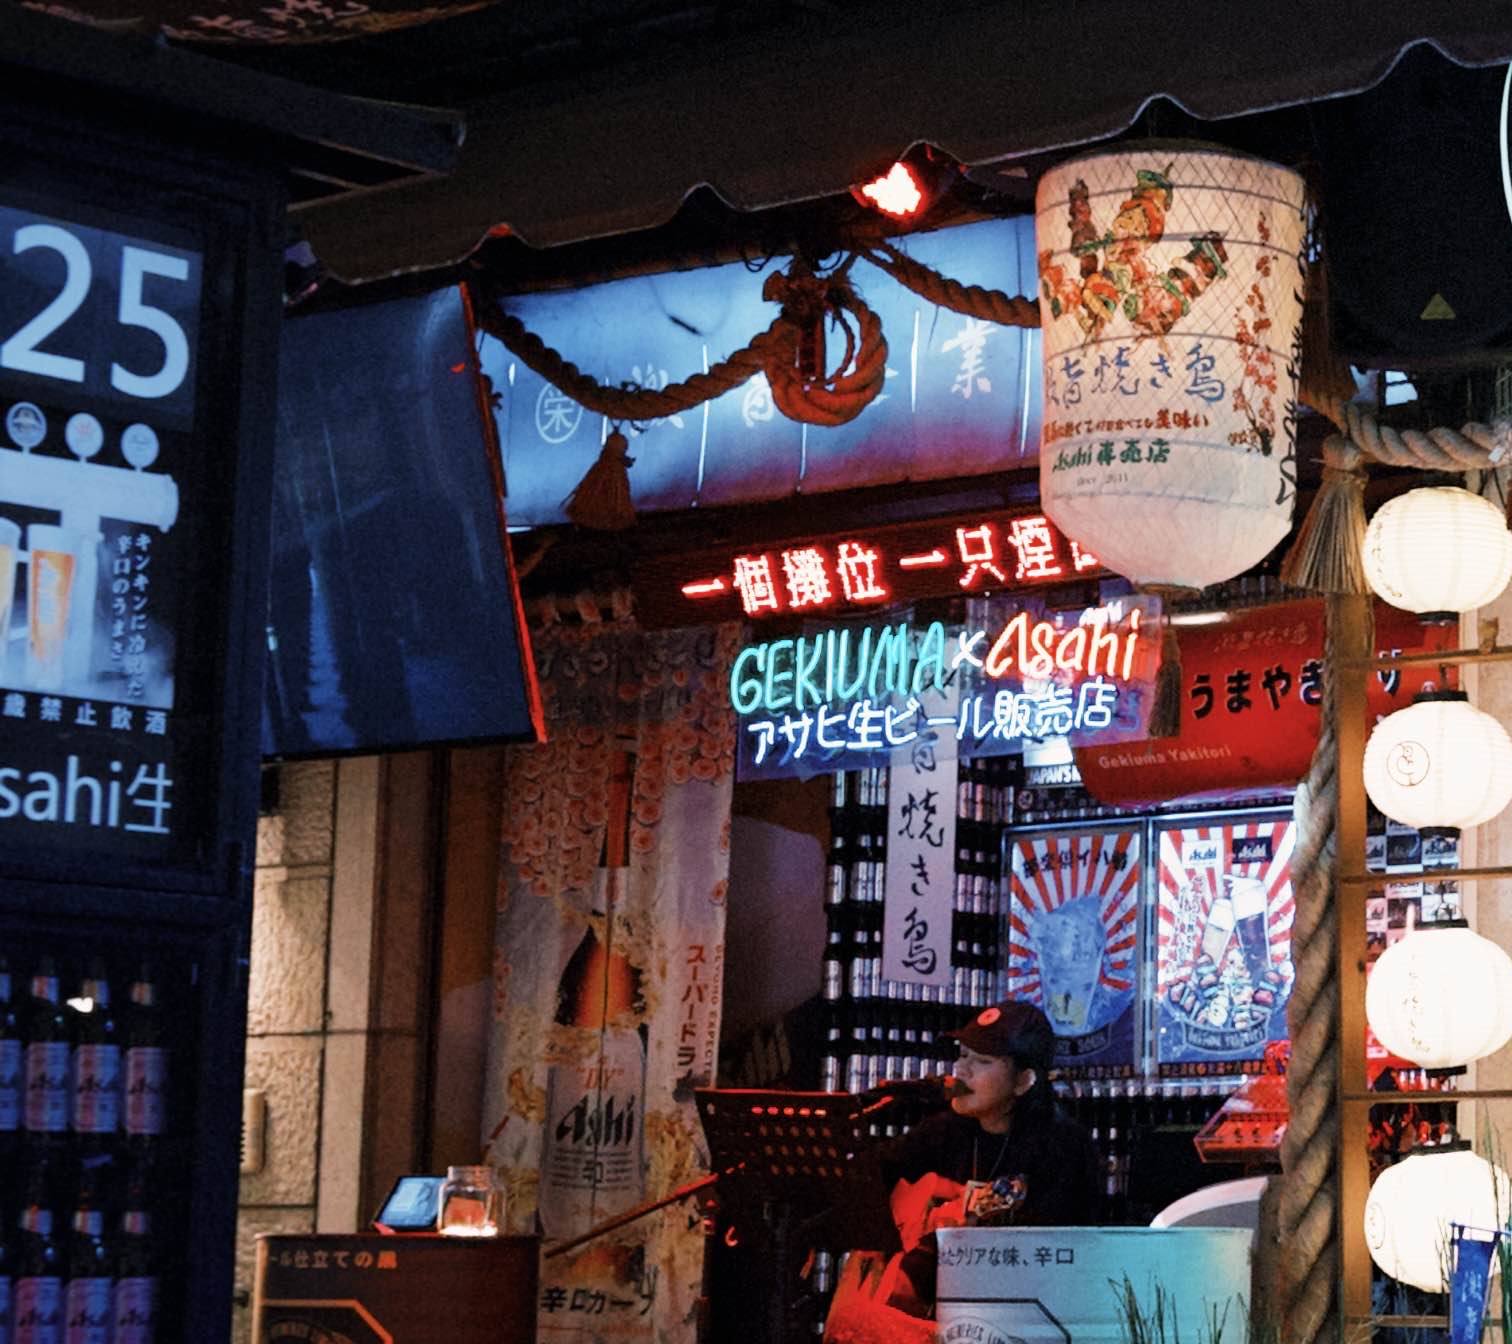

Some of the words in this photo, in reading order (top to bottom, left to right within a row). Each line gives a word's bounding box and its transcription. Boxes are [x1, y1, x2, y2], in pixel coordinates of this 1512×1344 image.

[0, 222, 190, 399] 25
[730, 621, 946, 714] GEKIUMA
[985, 608, 1142, 681] Asahi
[748, 674, 1118, 765] アサヒ生ビール販売店
[1099, 752, 1165, 770] Gekiuma
[1169, 743, 1232, 763] Yakitori
